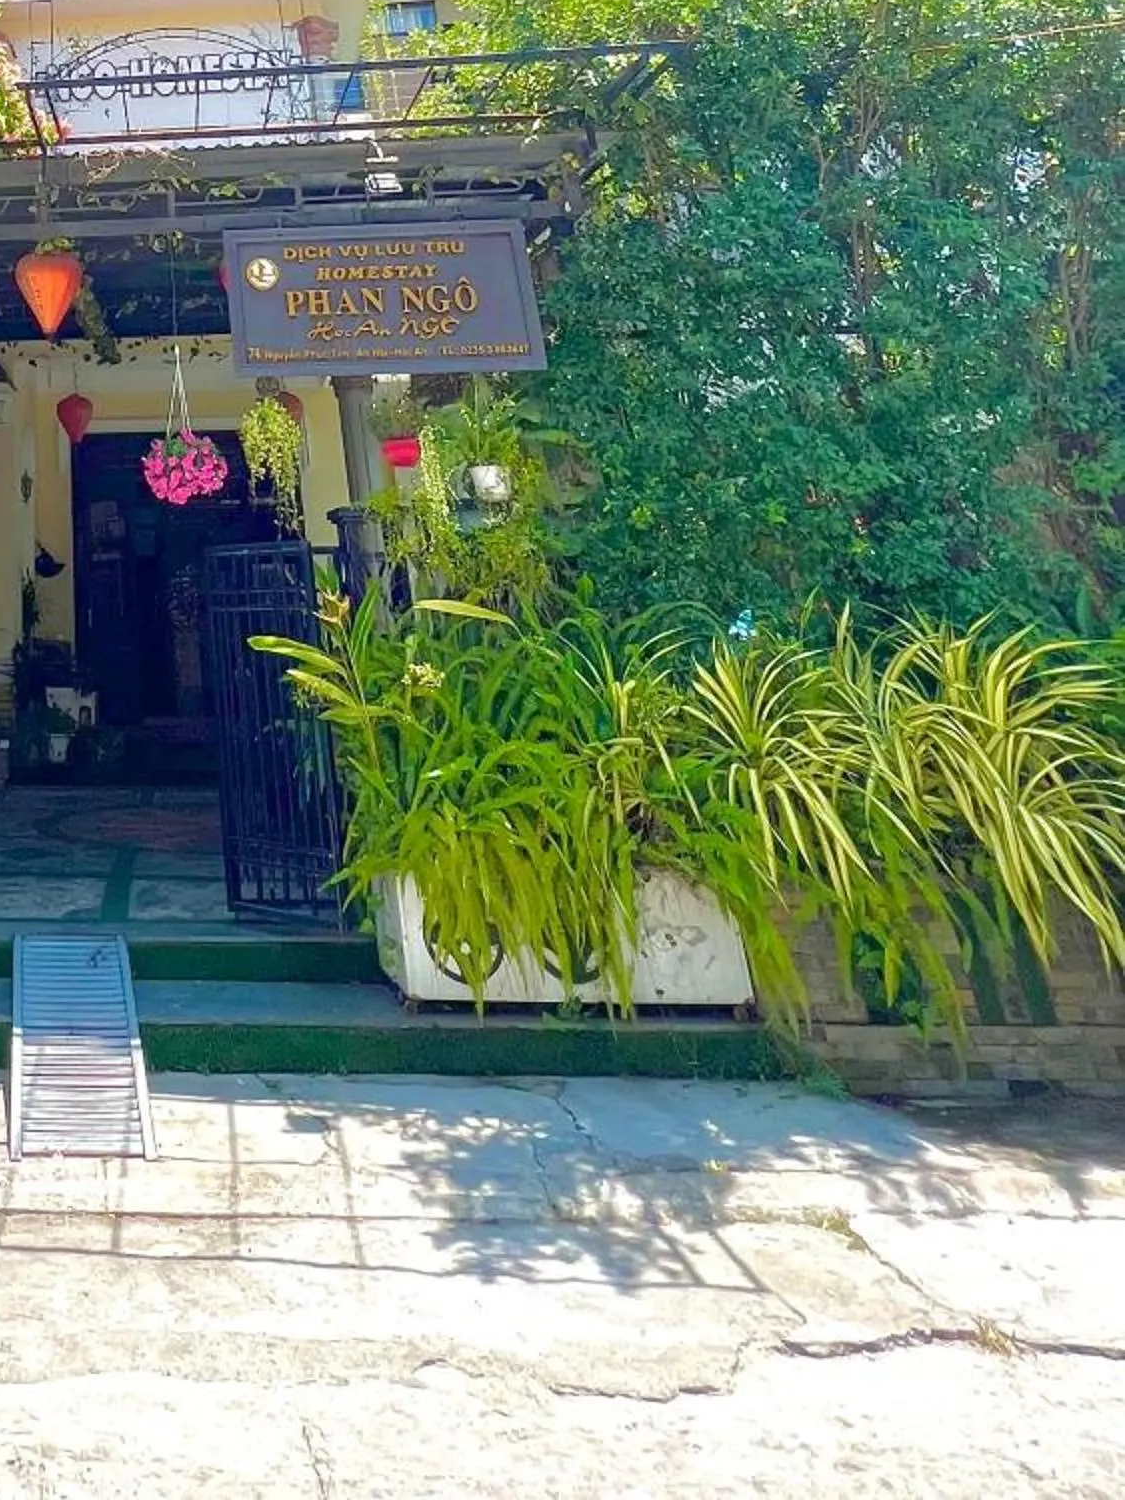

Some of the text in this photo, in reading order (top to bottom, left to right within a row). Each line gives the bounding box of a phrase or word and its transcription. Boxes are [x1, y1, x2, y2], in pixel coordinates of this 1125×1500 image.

[316, 264, 437, 281] HOMESTAY
[285, 276, 479, 319] PHAN NGÔ
